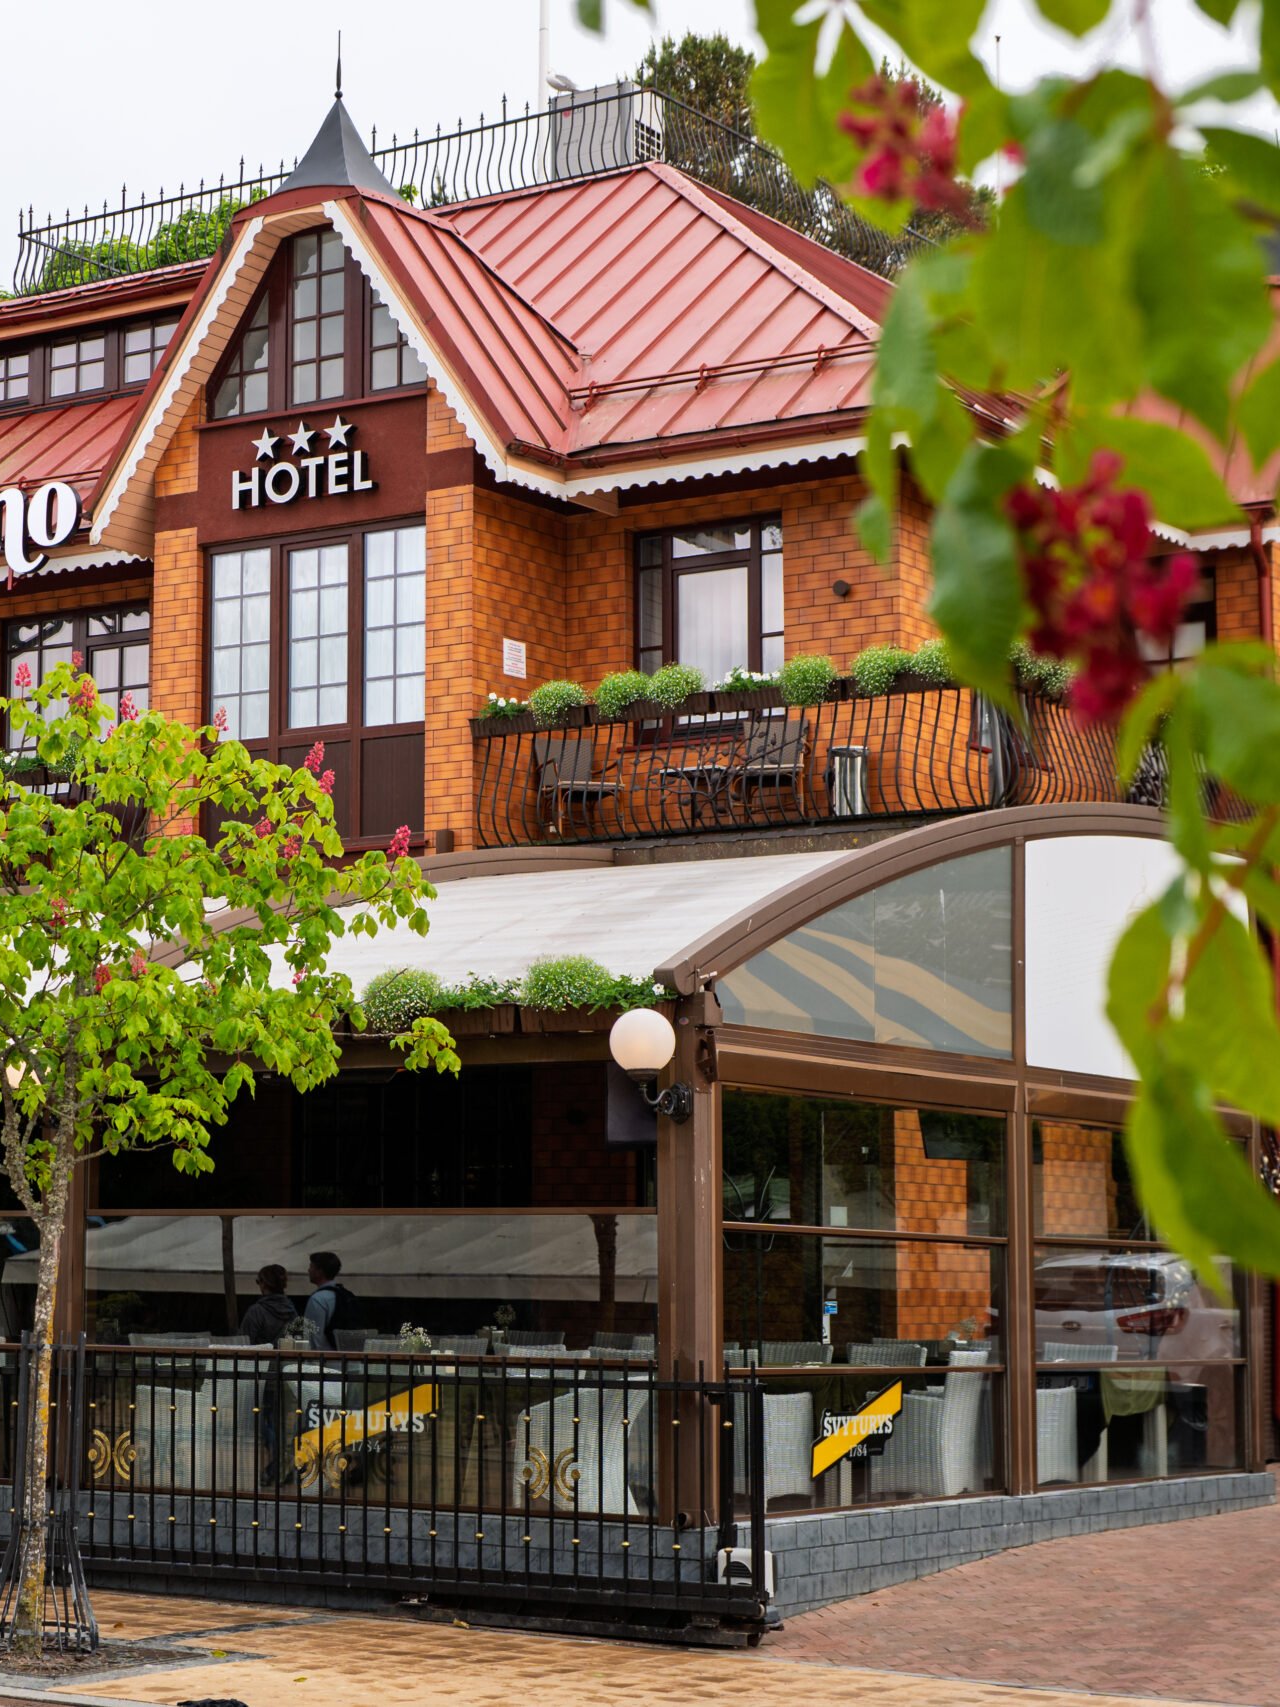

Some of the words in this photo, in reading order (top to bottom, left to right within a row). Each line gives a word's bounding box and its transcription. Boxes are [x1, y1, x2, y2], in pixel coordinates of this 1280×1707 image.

[231, 450, 373, 510] HOTEL
[308, 1403, 425, 1433] ŠVYTURYS
[823, 1411, 893, 1437] ŠVYTURYS
[849, 1444, 867, 1458] 1784
